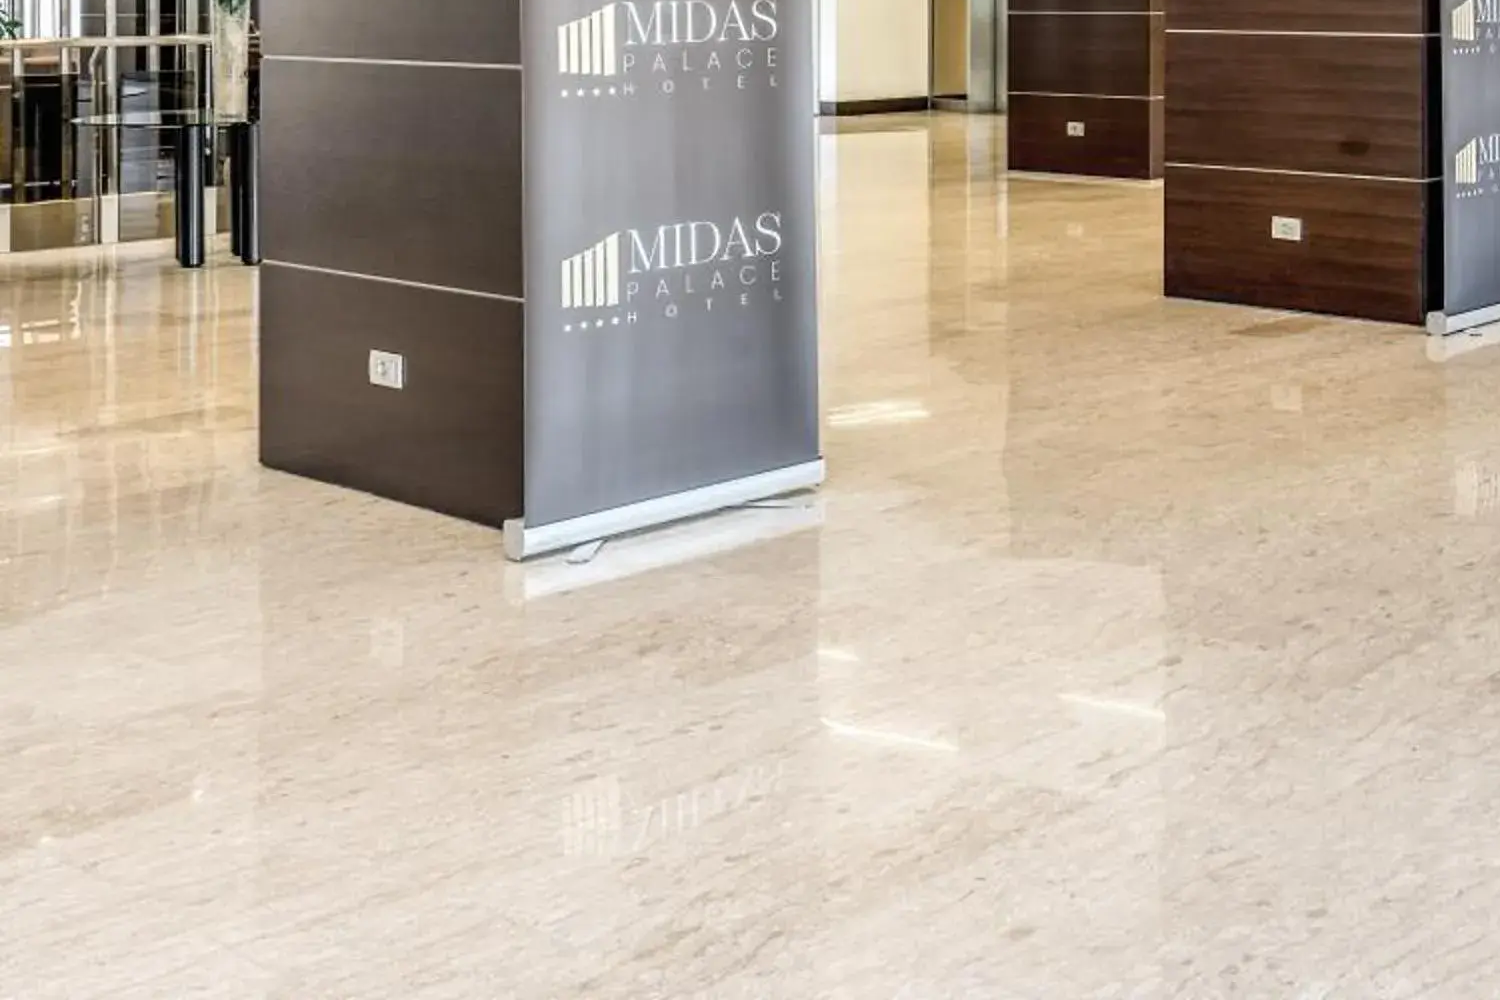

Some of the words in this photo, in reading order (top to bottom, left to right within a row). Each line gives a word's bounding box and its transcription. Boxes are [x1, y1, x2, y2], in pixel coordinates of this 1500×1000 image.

[622, 47, 777, 72] PALACE
[622, 74, 778, 96] HOTEL
[626, 212, 782, 274] MIDAS
[626, 260, 781, 302] PALACE
[627, 289, 783, 325] HOTEL
